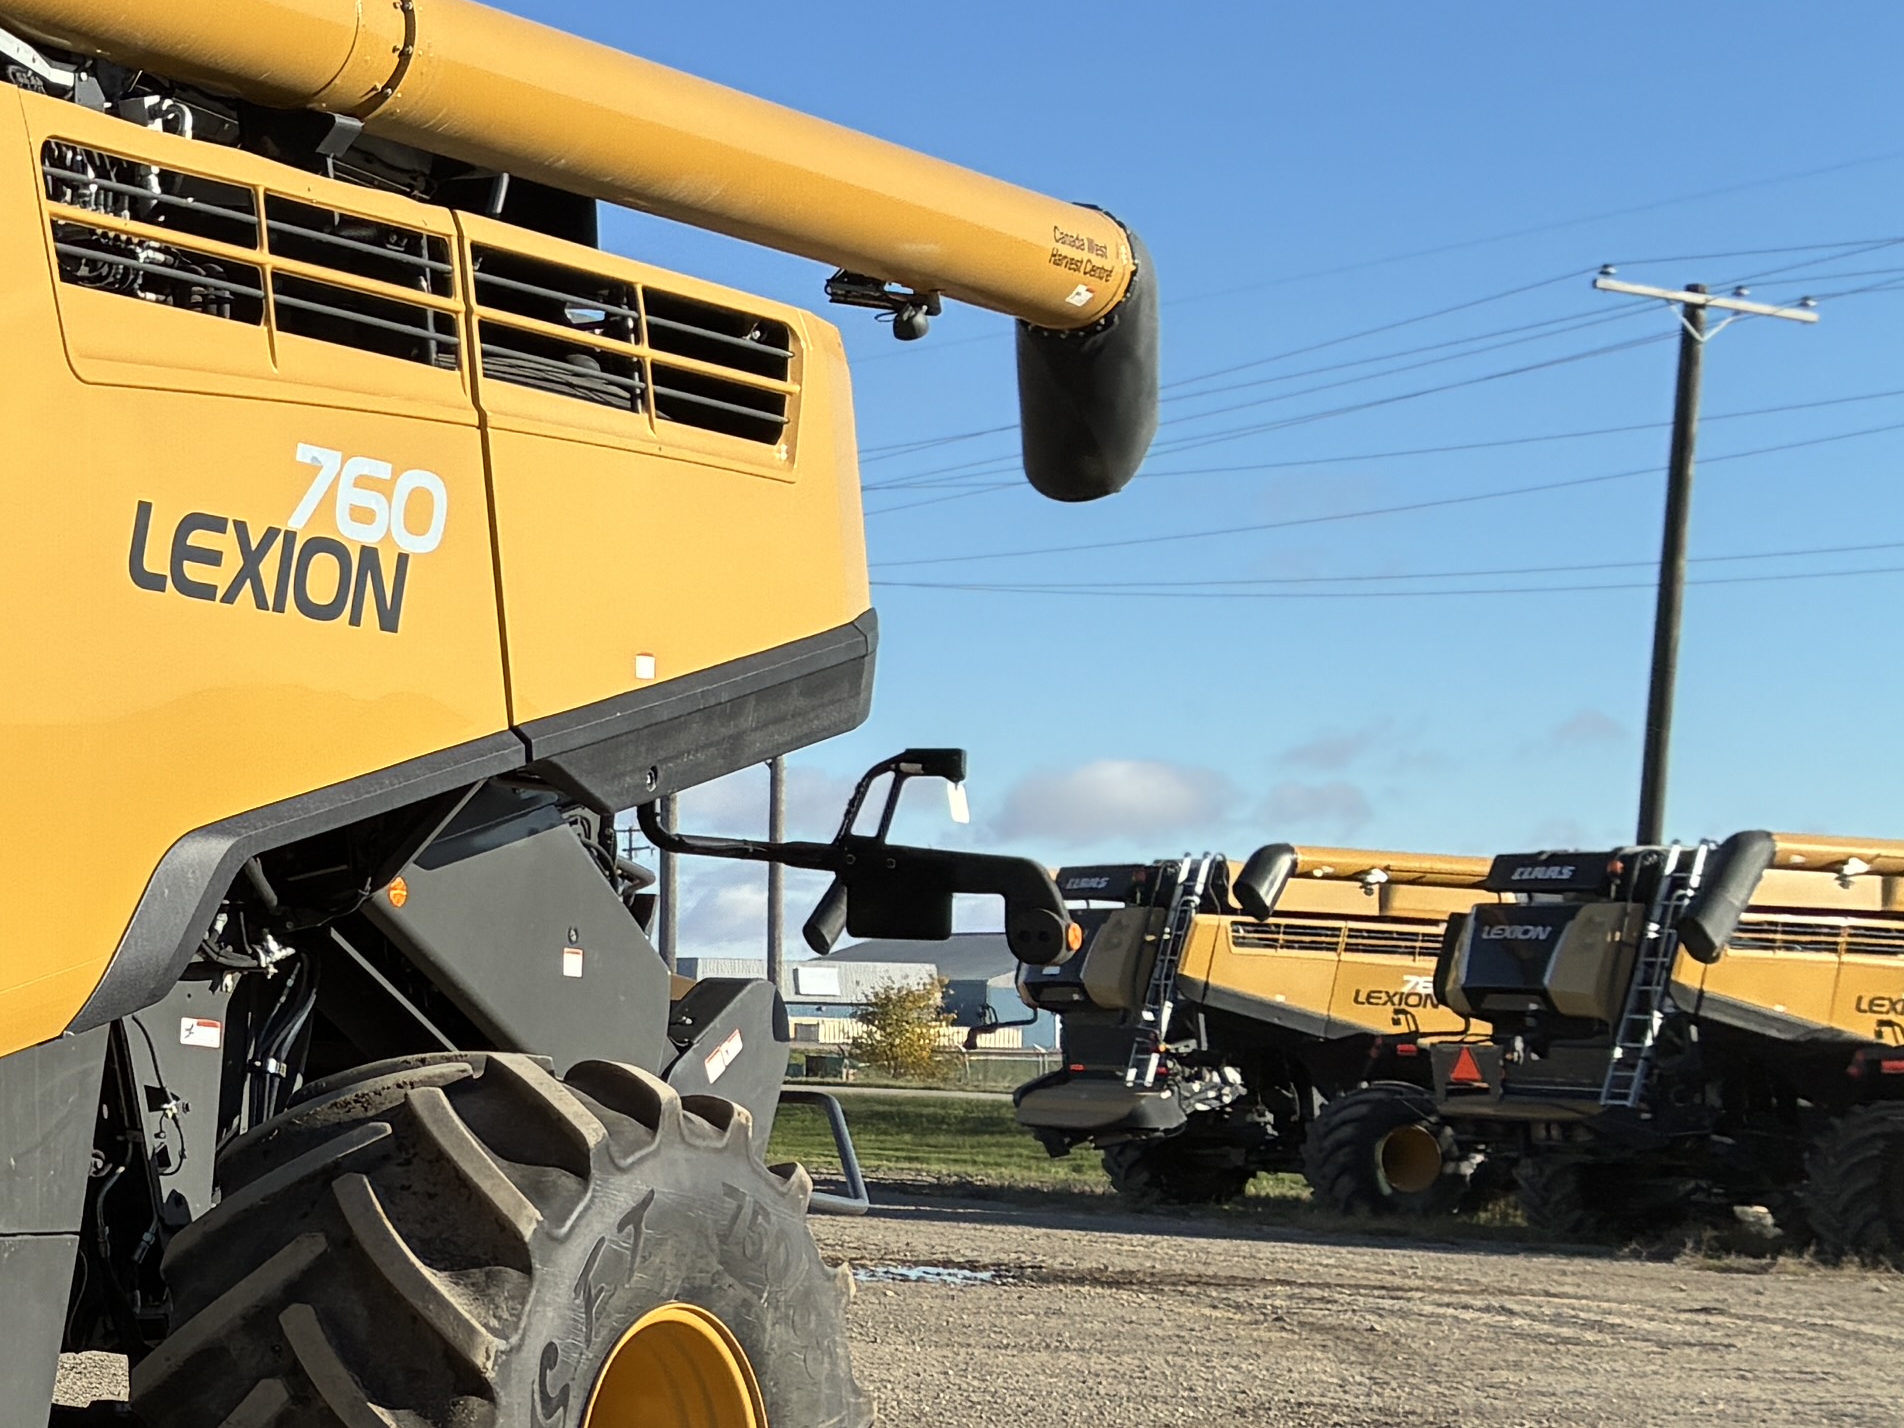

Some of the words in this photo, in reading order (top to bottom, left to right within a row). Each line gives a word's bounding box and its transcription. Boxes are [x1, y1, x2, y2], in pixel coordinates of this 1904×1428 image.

[1053, 225, 1086, 251] Canada
[1048, 247, 1084, 273] Harvest
[287, 442, 448, 554] 760
[128, 499, 410, 634] LEXION
[1511, 865, 1576, 880] CLAAS
[1481, 925, 1552, 940] LEXION
[1353, 988, 1439, 1009] LEXION
